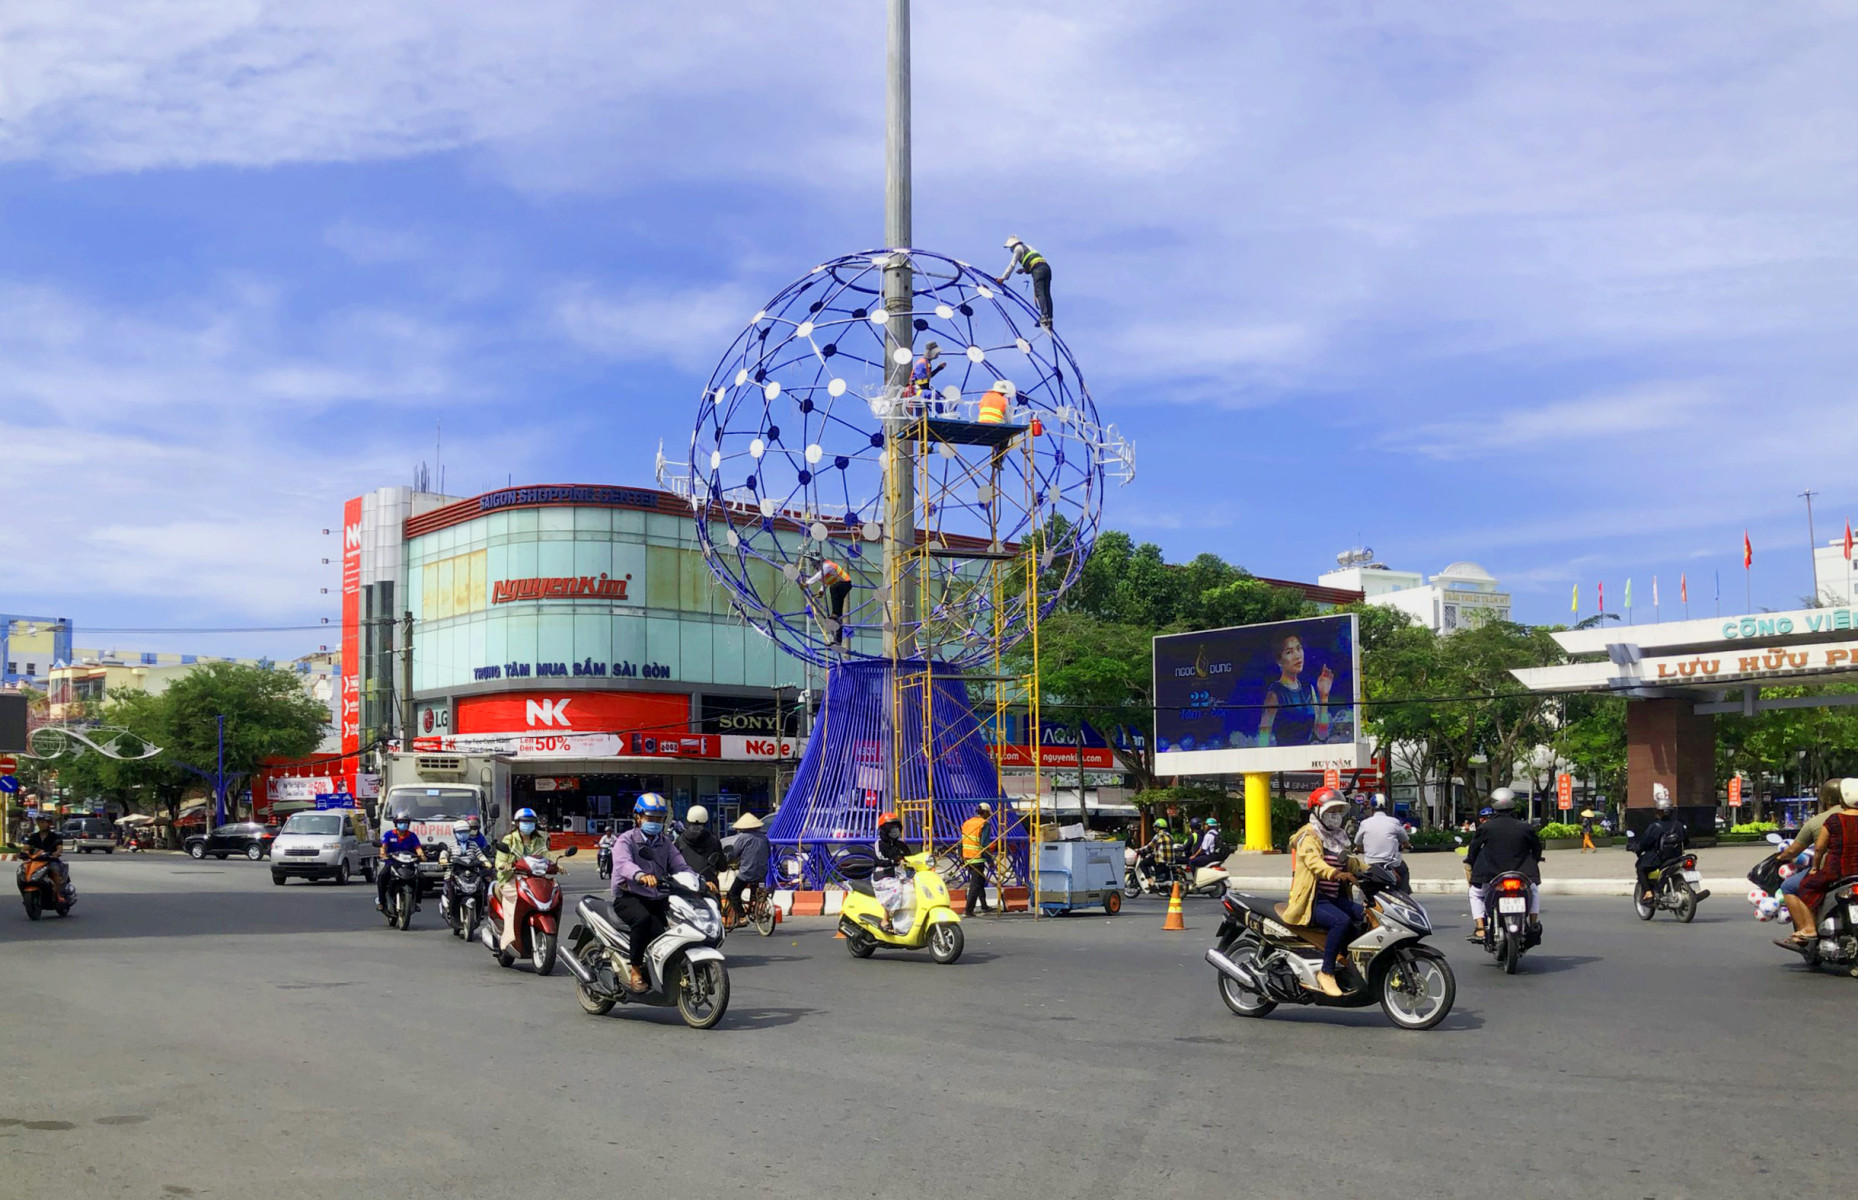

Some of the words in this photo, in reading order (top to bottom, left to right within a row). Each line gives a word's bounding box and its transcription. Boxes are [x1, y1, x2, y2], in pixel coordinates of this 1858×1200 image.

[479, 489, 516, 511] SAIGON
[519, 487, 595, 504] SHOPPING
[600, 490, 659, 508] CENTER
[1722, 616, 1794, 640] CÔNG
[1805, 609, 1858, 632] VIÊ
[473, 665, 501, 680] TRUNG
[504, 661, 530, 677] TÂM
[536, 663, 568, 677] MUA
[572, 657, 606, 677] SẮM
[612, 660, 637, 677] SÀI
[642, 662, 670, 679] GÒN
[1657, 656, 1720, 678] LƯU
[1738, 648, 1809, 672] HỮU
[435, 710, 448, 728] LG
[525, 698, 573, 727] NK
[719, 714, 777, 730] SONY
[535, 735, 571, 752] 50%
[745, 739, 791, 756] NKae
